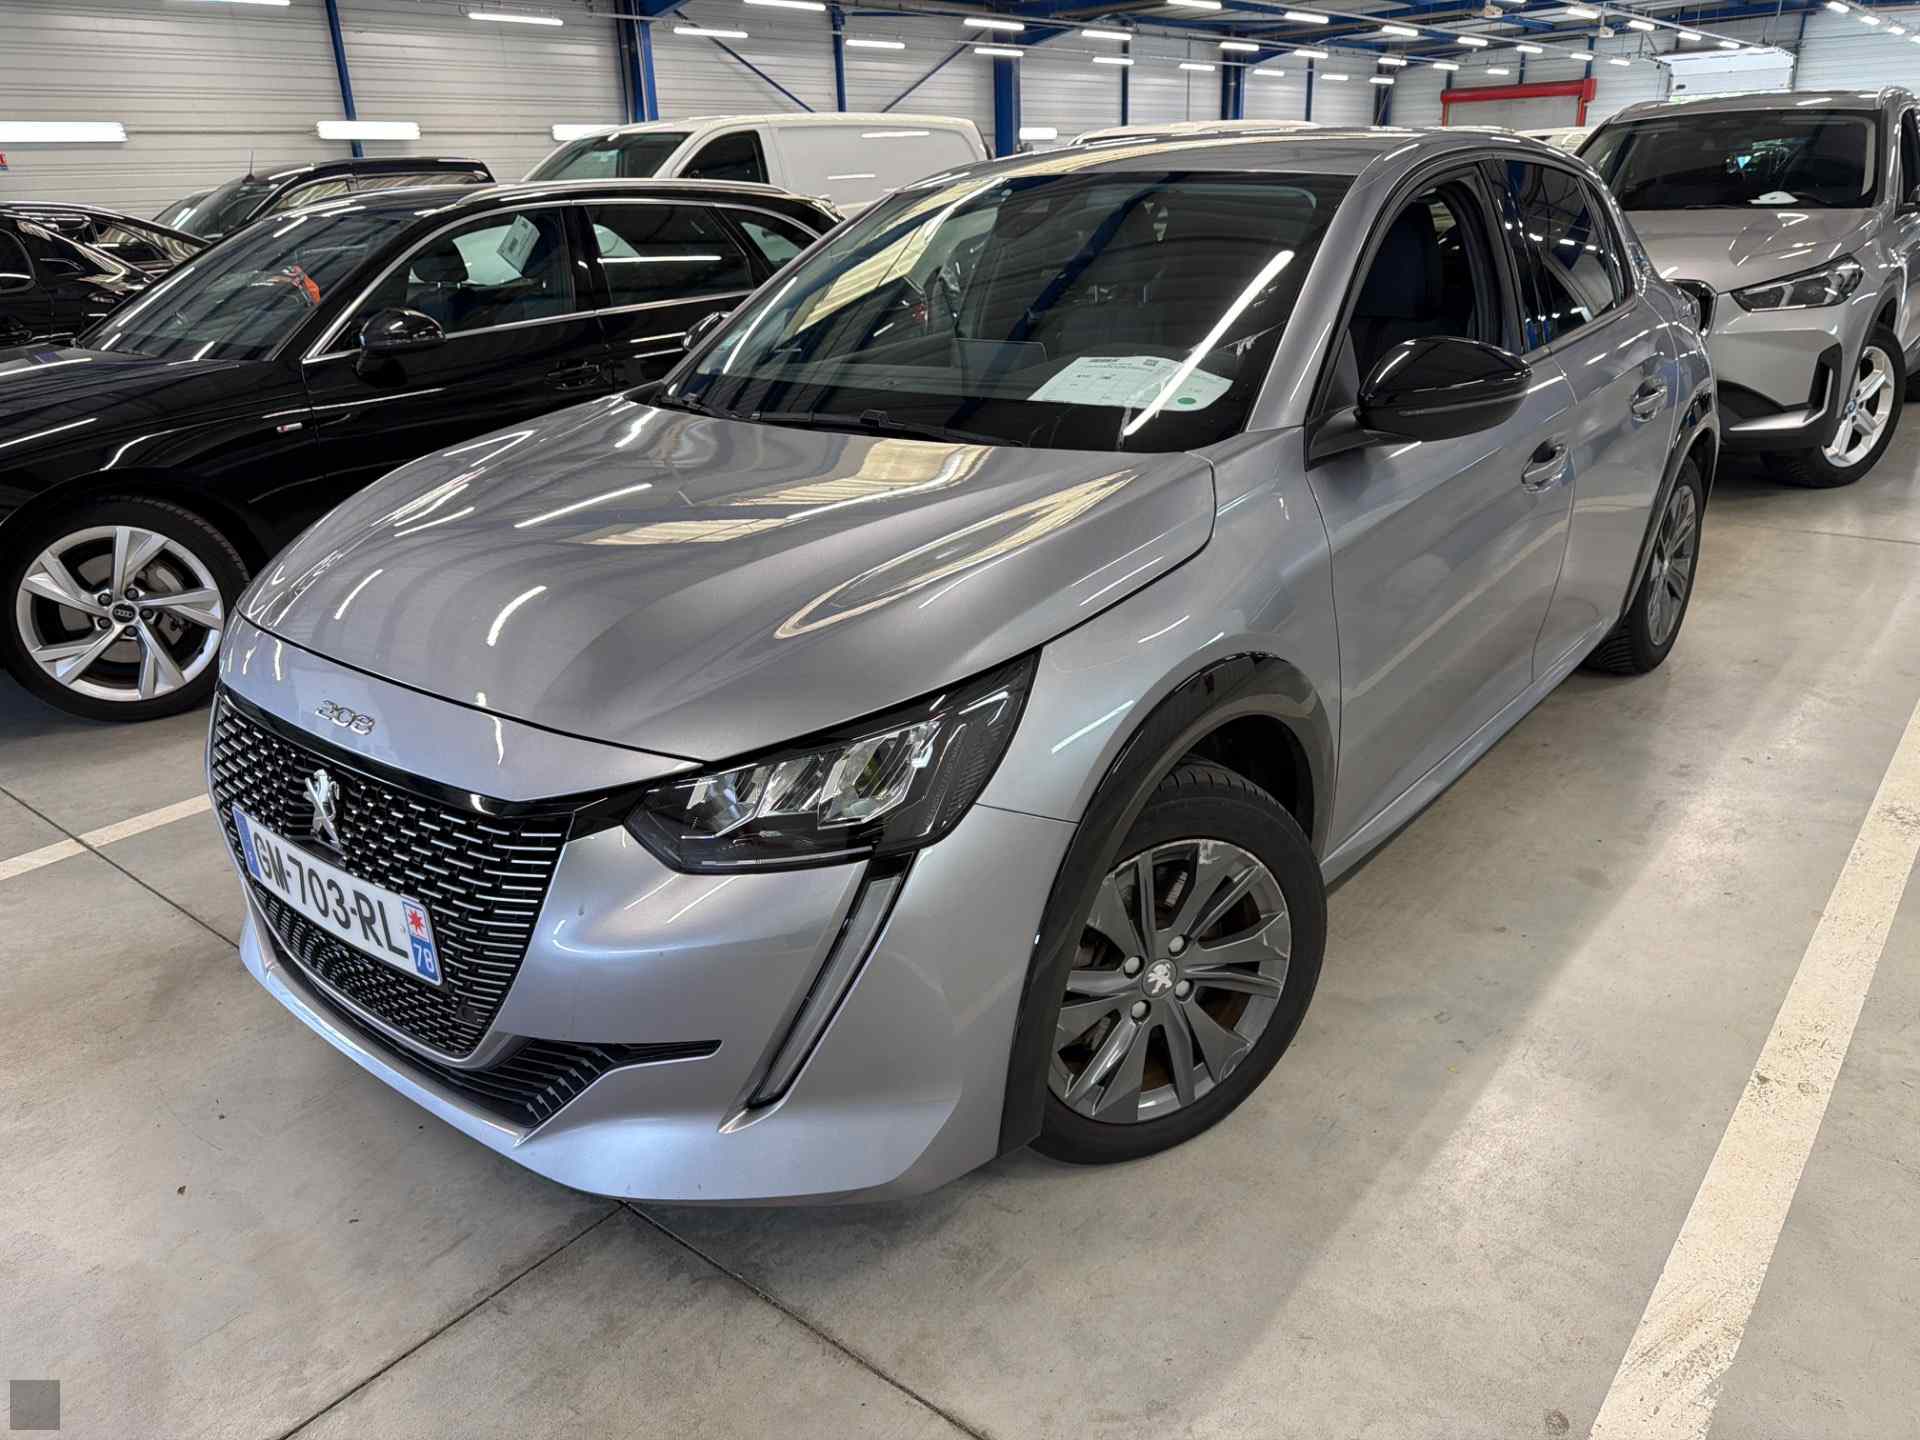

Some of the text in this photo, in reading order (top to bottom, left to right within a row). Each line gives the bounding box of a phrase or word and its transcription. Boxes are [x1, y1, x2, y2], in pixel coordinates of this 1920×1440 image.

[315, 700, 375, 735] 208
[253, 831, 409, 959] GM-703-RL
[412, 945, 435, 973] 78
